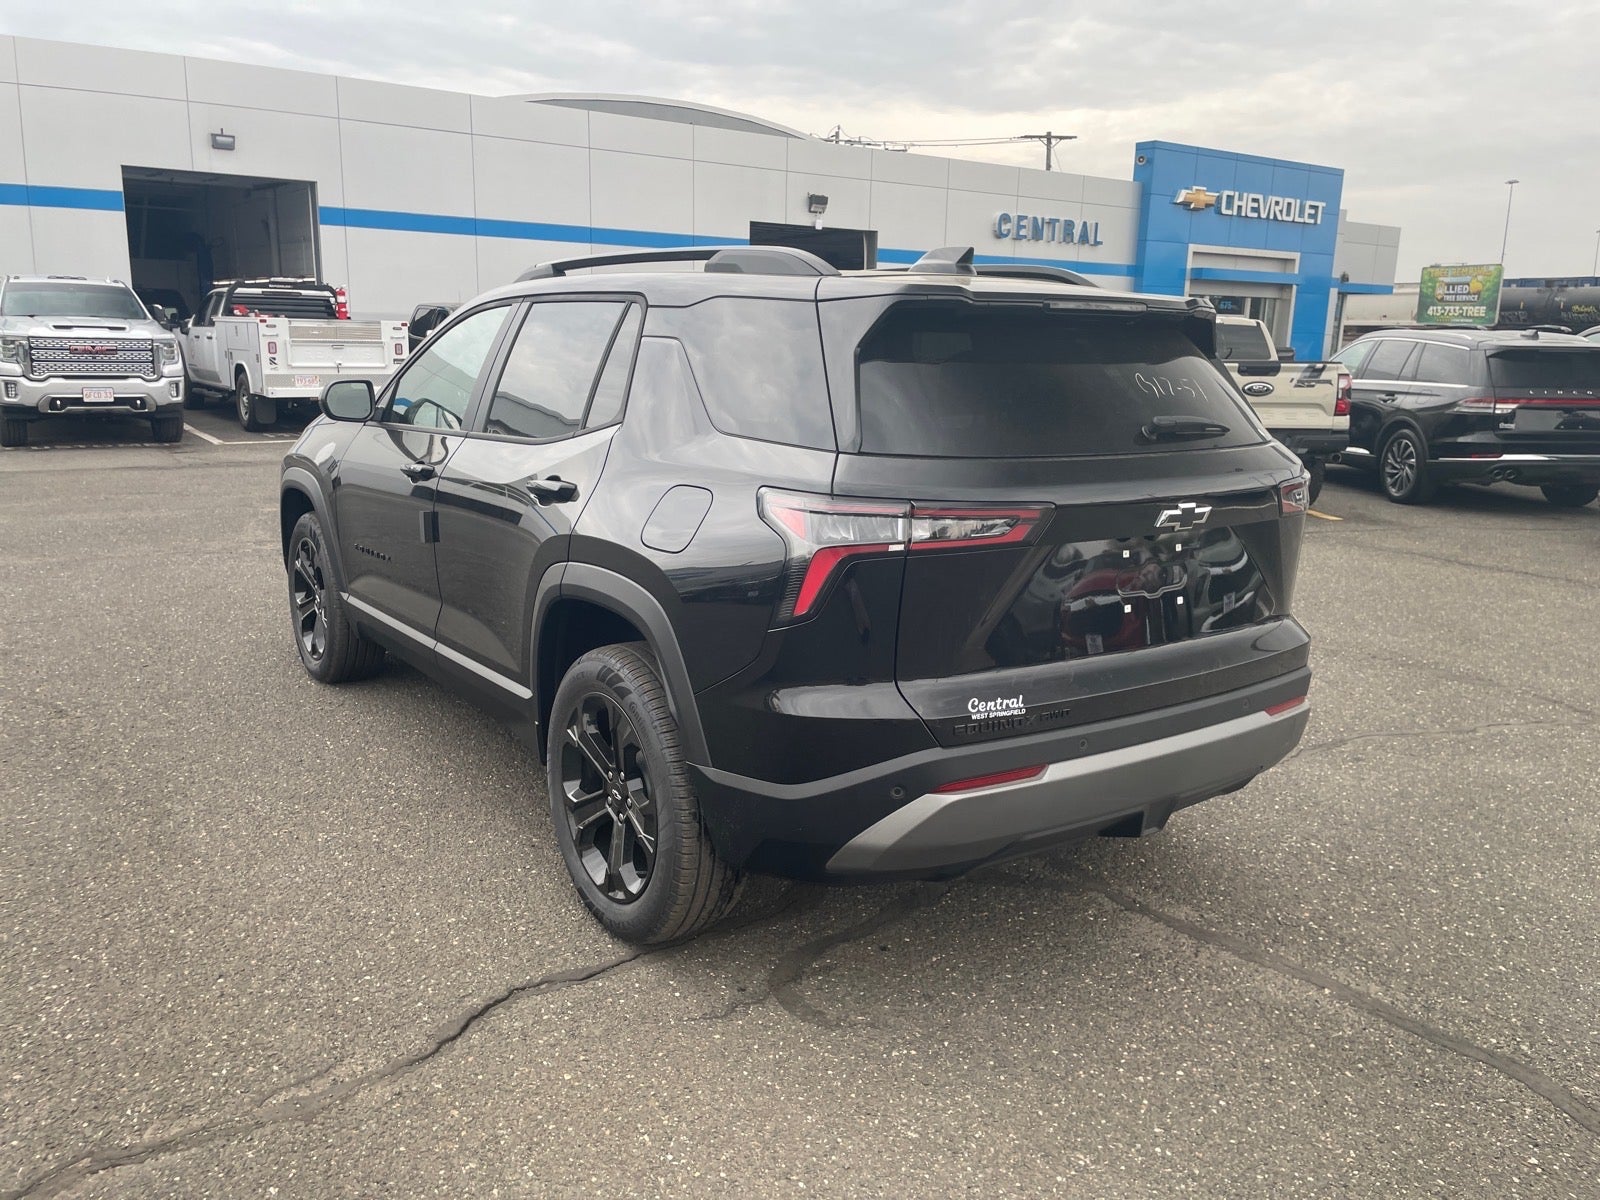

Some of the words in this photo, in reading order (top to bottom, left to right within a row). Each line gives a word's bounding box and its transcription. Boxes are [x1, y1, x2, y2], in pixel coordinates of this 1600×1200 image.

[1219, 190, 1326, 225] CHEVROLET
[994, 212, 1103, 246] CENTRAL
[70, 345, 117, 355] GMC
[968, 695, 1024, 712] Central
[971, 712, 989, 720] WEST
[989, 709, 1026, 718] SPRINGFIELD
